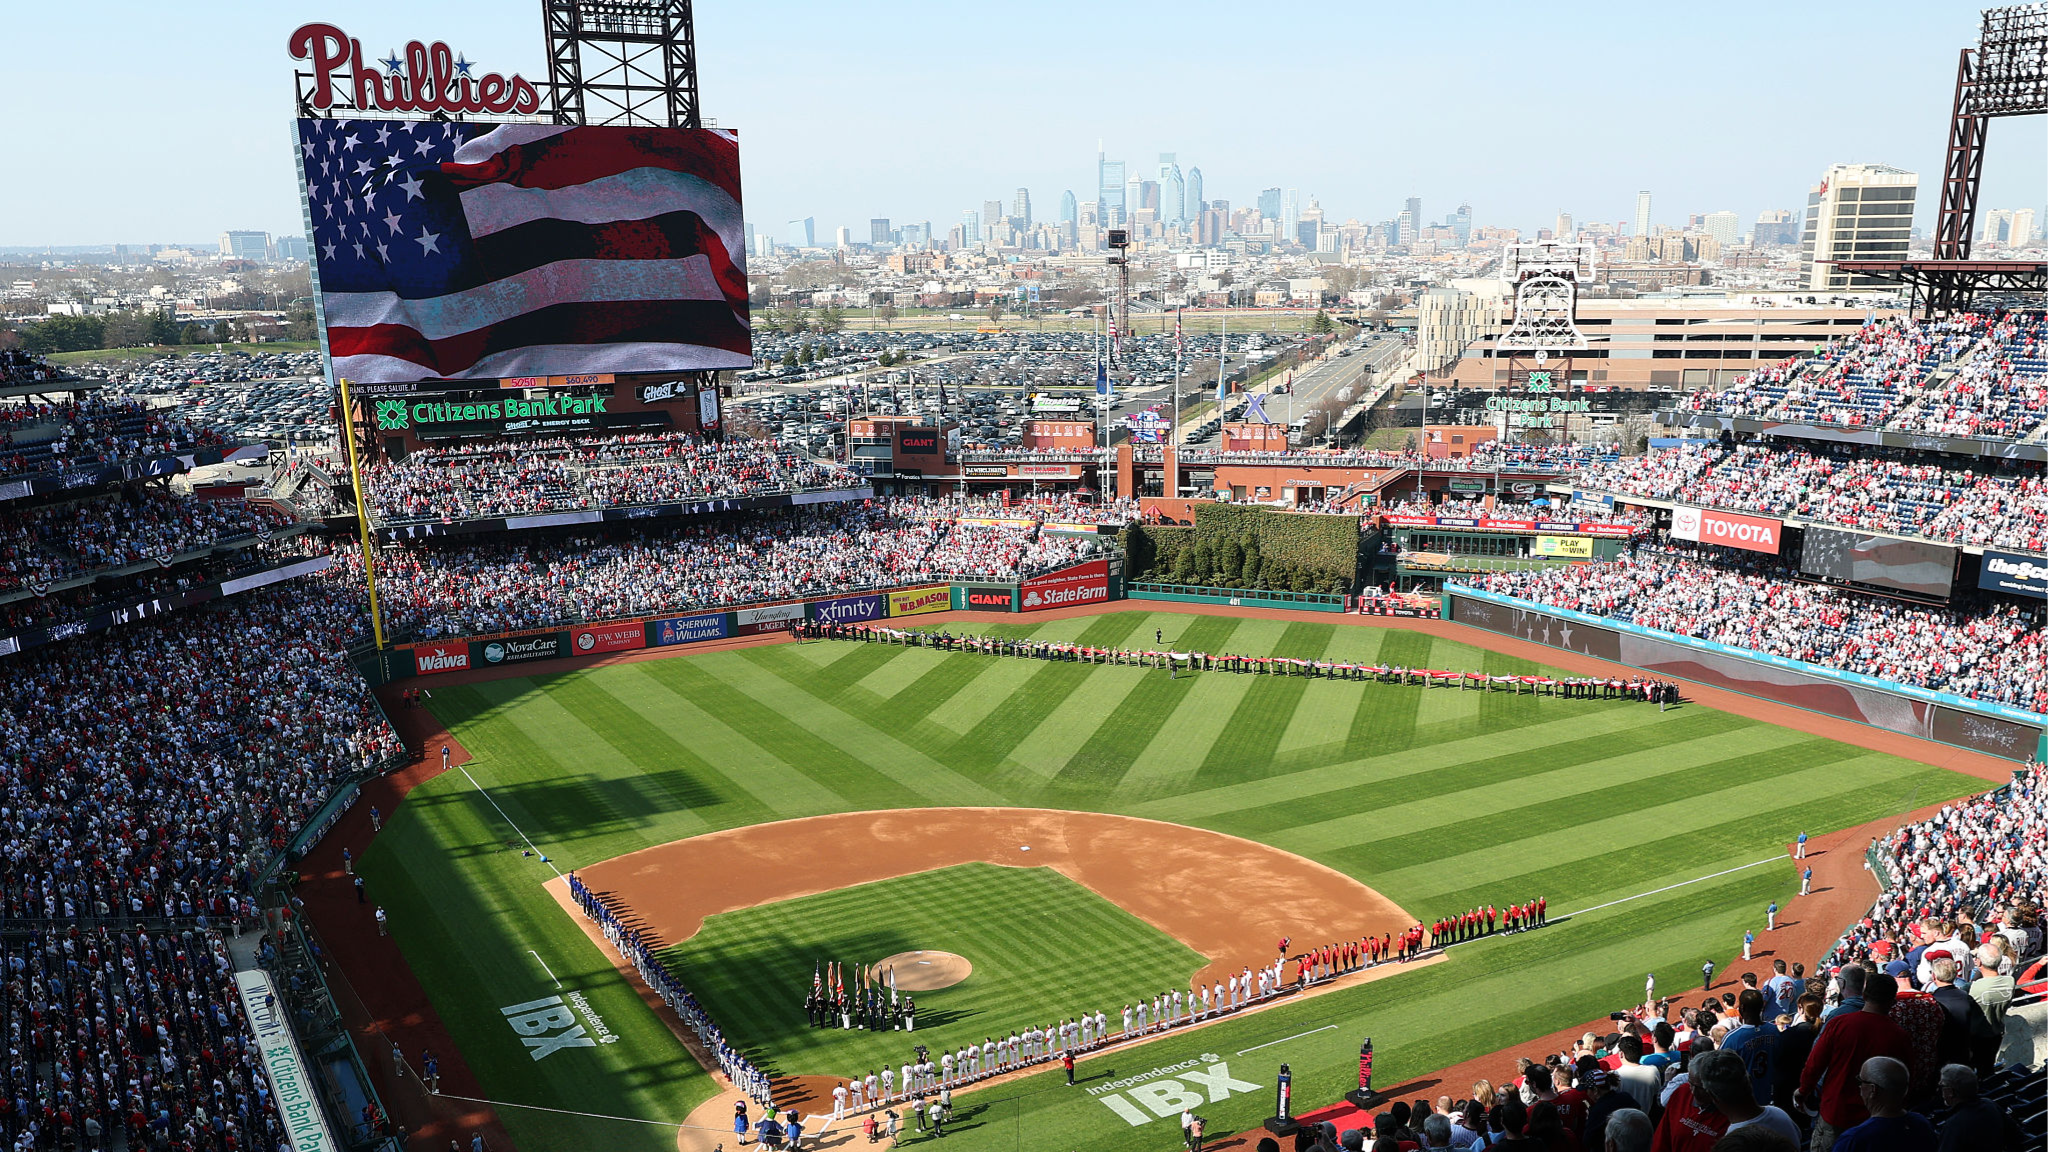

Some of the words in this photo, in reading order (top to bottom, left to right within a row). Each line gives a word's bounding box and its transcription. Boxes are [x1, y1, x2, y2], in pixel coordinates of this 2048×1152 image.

[288, 22, 541, 115] Phillies
[565, 375, 598, 385] $60,490
[336, 386, 366, 395] VRANS.
[367, 385, 388, 394] PLEASE
[411, 383, 418, 391] AT
[643, 382, 677, 403] GHOST
[413, 401, 501, 423] Citizens
[504, 398, 558, 418] Bank
[561, 394, 607, 415] Park
[1486, 396, 1548, 411] Citizens
[1550, 397, 1591, 412] Bank
[1520, 414, 1553, 428] Park
[903, 439, 935, 447] GIANT
[1496, 521, 1527, 529] Budweiser
[1596, 525, 1629, 533] Budweiser
[1704, 518, 1774, 545] TOYOTA
[1560, 539, 1580, 547] PLAY
[1569, 547, 1588, 555] WIN!
[969, 594, 1011, 605] GIANT
[1229, 598, 1241, 606] 401
[751, 610, 792, 623] Yuengling
[820, 600, 876, 621] xfinity
[553, 623, 590, 632] ASPLUNDH
[676, 617, 719, 631] SHERWIN
[758, 621, 785, 631] LAGER
[508, 628, 546, 638] ASPLUNDH
[615, 629, 641, 639] WEBB
[506, 638, 557, 654] NovaCare
[506, 650, 556, 660] REHABILITATION
[418, 654, 467, 671] Wawa
[2001, 708, 2035, 720] Independence
[1778, 986, 1795, 1000] 20
[245, 984, 282, 1038] WELCOME
[567, 990, 610, 1036] Independence
[500, 995, 597, 1061] IBX
[1359, 1052, 1373, 1087] Phillies
[270, 1057, 303, 1103] Citizens
[1085, 1058, 1200, 1096] Independence
[1098, 1062, 1265, 1127] IBX
[286, 1101, 321, 1135] Bank
